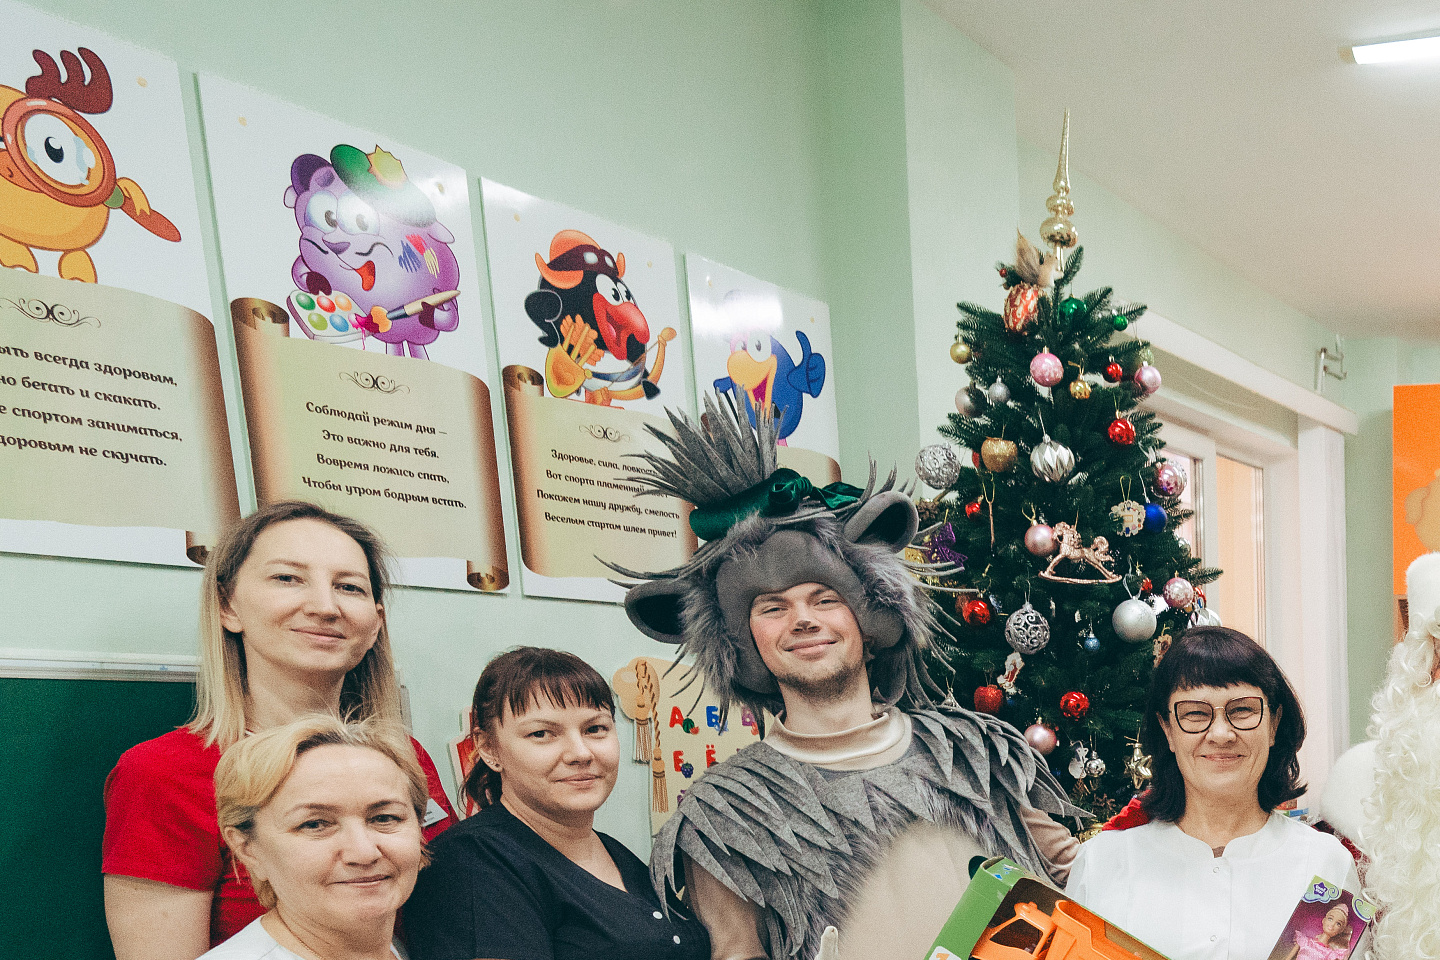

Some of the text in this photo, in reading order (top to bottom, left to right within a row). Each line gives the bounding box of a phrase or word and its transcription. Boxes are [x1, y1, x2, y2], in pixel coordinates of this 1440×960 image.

[33, 351, 91, 370] всегда
[21, 376, 75, 396] бегать
[79, 388, 91, 399] и
[94, 391, 161, 410] скакать.
[12, 407, 83, 425] спортом
[305, 401, 370, 423] Соблюдай
[372, 416, 413, 431] режим
[415, 424, 436, 435] дня
[78, 445, 98, 457] не
[102, 449, 167, 466] скучать.
[322, 429, 439, 459] Это важно для тебя.
[316, 453, 370, 470] Вовремя
[372, 464, 415, 478] ложись
[545, 469, 562, 481] Вот
[564, 474, 595, 487] спорта
[301, 476, 467, 509] Чтобы утром бодрым встать.
[536, 488, 581, 505] Покажем
[582, 498, 607, 511] нашу
[644, 508, 680, 520] смелость
[544, 511, 677, 539] Веселым стартам шлем привет!
[669, 706, 685, 728] А
